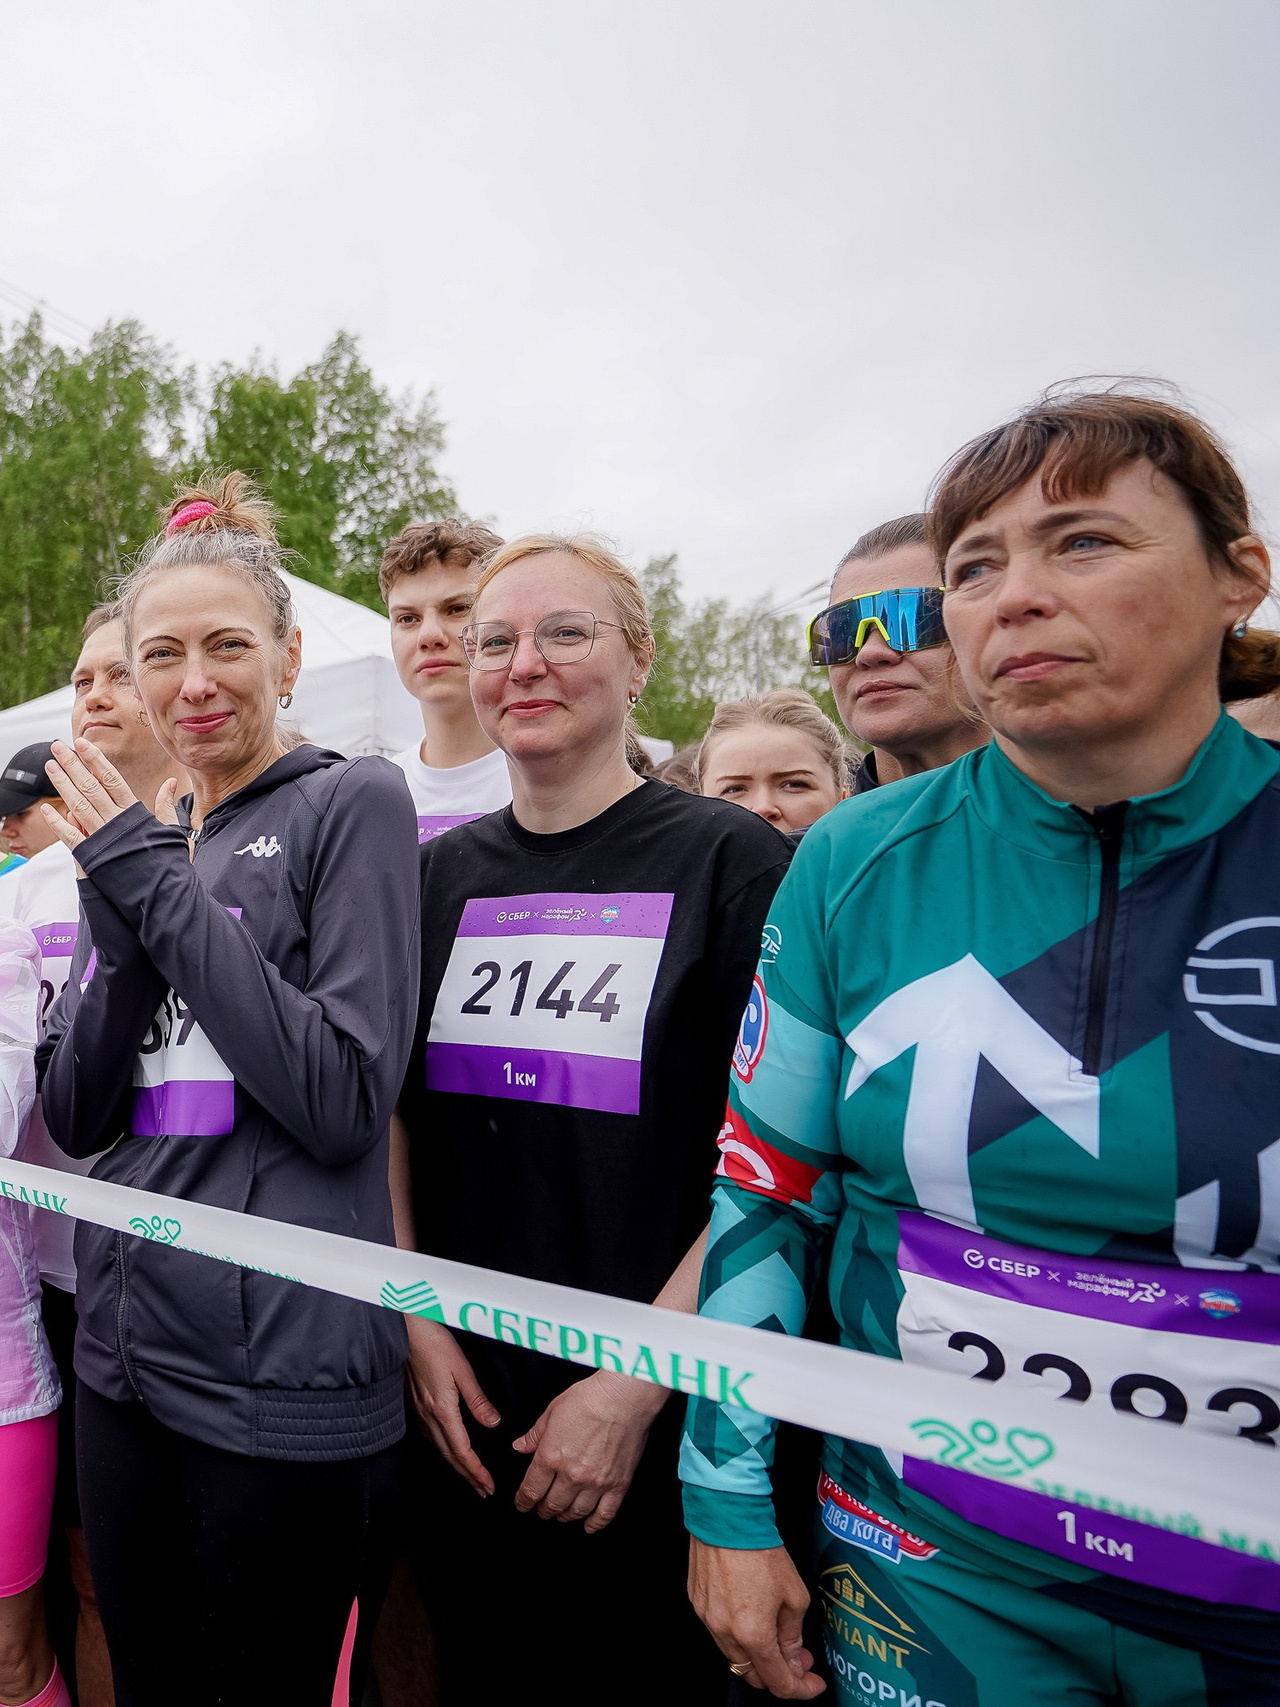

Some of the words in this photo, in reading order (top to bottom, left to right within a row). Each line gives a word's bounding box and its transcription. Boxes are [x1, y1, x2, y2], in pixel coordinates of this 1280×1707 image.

[508, 912, 530, 920] СБЕР
[461, 961, 622, 1022] 2144
[988, 1257, 1041, 1278] СБЕР
[459, 1302, 755, 1410] СБЕРБАНК
[833, 1649, 947, 1707] ЮГОРИ
